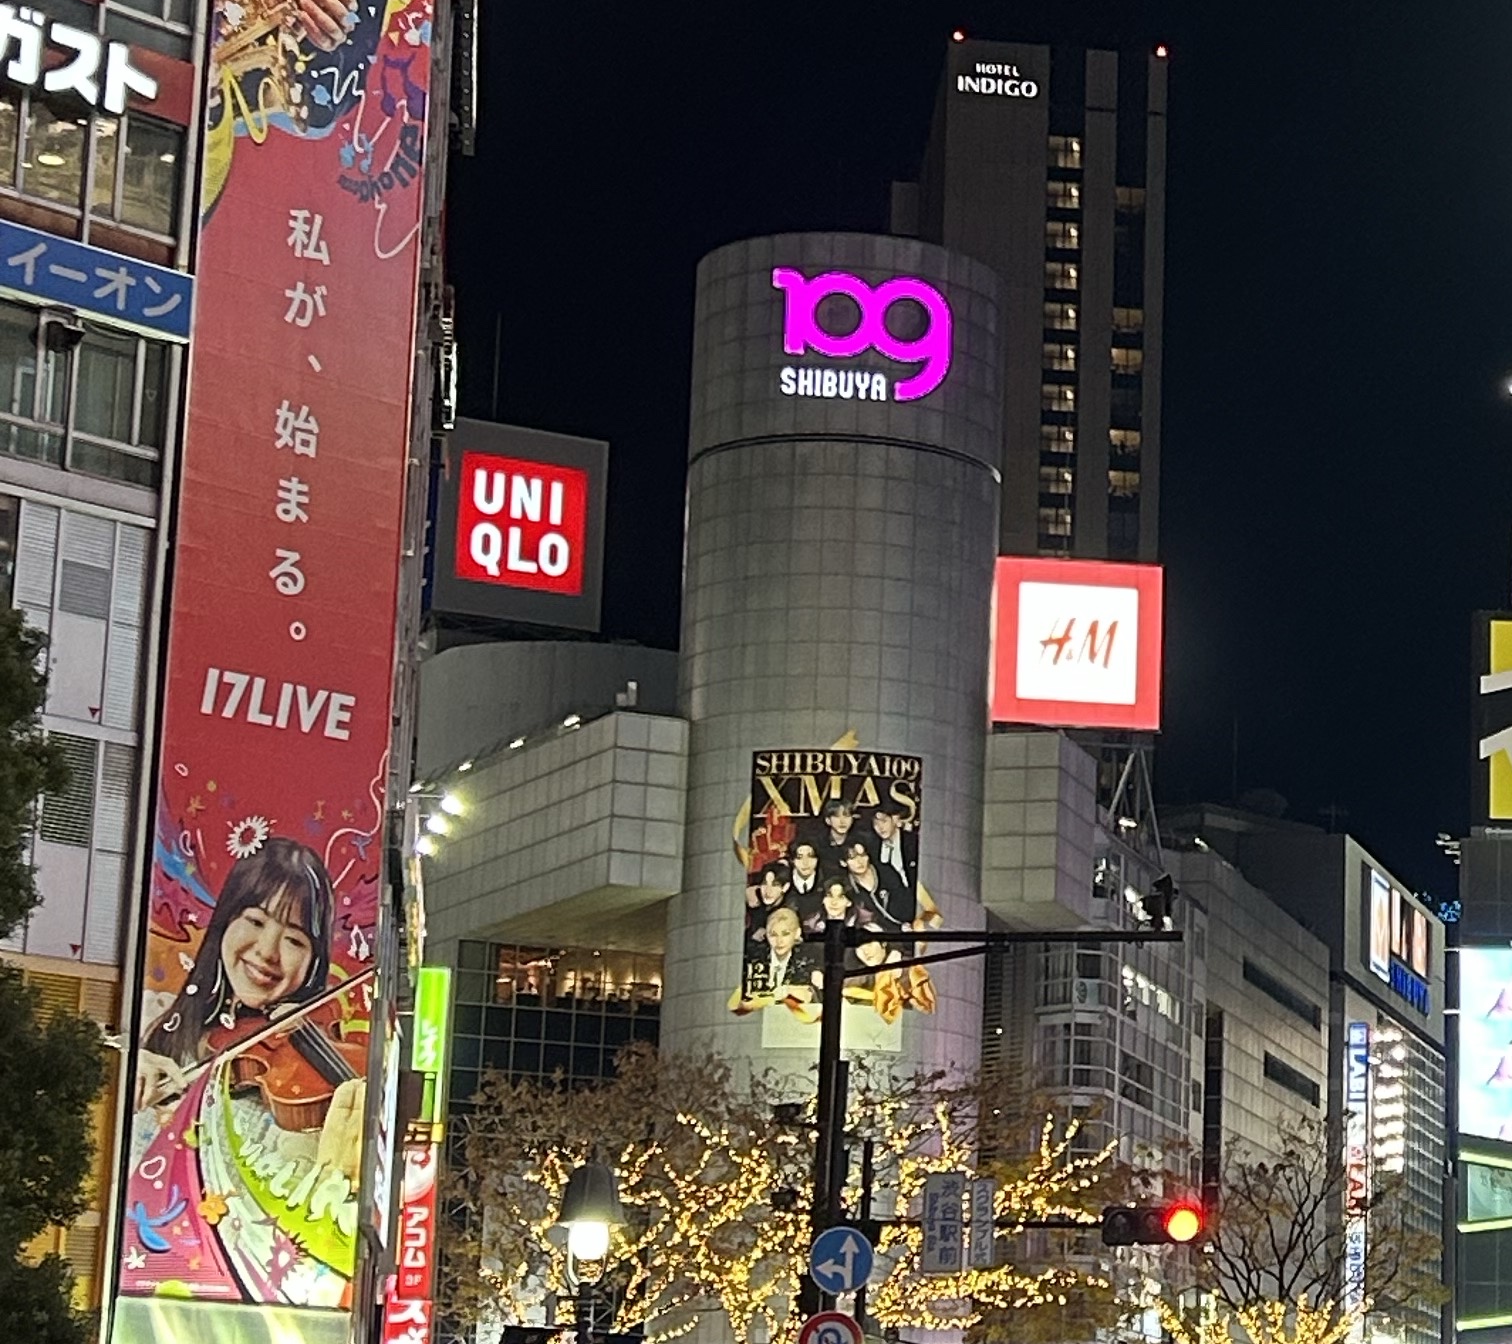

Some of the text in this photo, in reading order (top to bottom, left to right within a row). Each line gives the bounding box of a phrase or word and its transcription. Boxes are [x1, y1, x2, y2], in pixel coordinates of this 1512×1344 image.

[957, 75, 1038, 98] INDIGO
[975, 62, 1020, 77] HOTEL
[10, 241, 182, 318] イーオン
[772, 267, 954, 402] 109
[780, 367, 887, 401] SHIBUYA
[268, 208, 331, 642] 私が、始まる。
[473, 467, 565, 526] UNI
[469, 522, 570, 577] QLO
[1037, 616, 1119, 670] H&M
[200, 667, 356, 742] 17LIVE
[755, 751, 920, 781] SHIBUYA109
[403, 1207, 429, 1269] アコム
